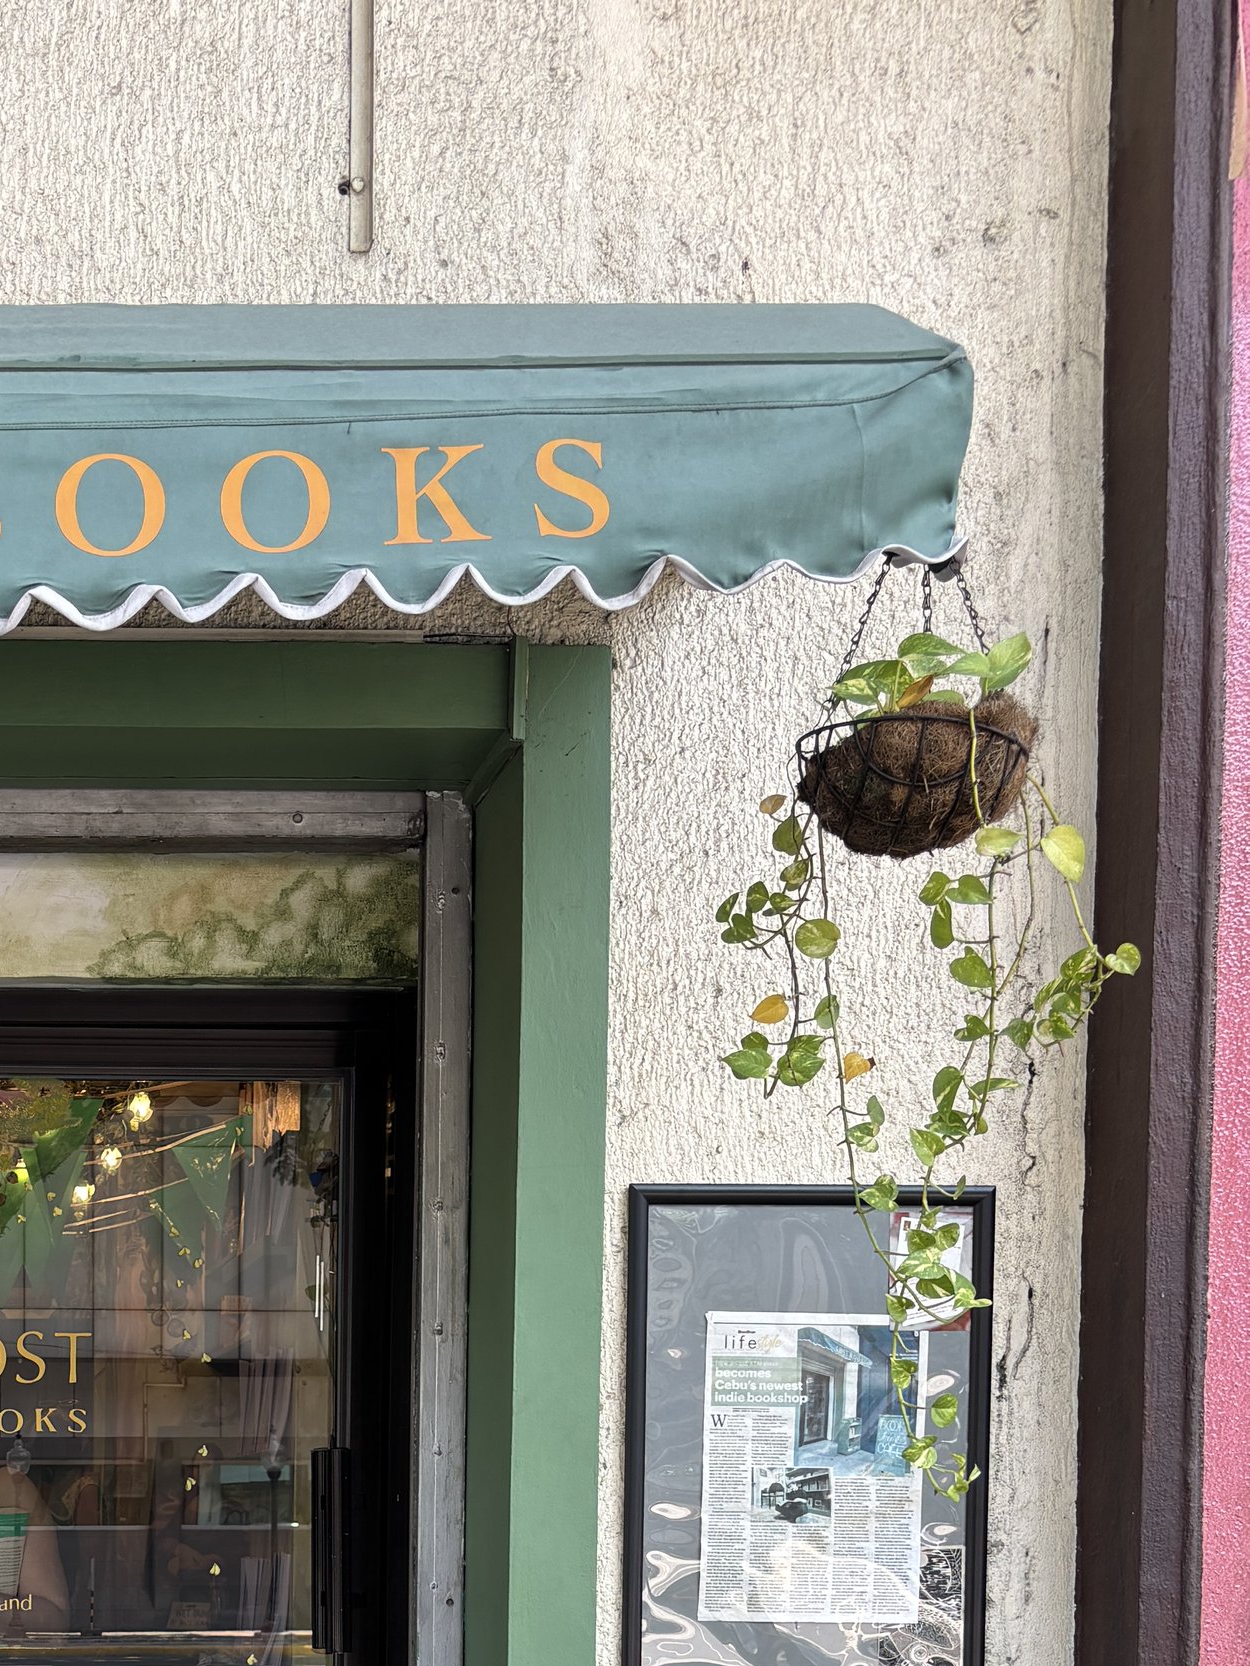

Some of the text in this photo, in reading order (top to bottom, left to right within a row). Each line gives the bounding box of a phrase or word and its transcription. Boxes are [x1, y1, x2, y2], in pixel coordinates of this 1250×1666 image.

[715, 1367, 771, 1378] becomes
[715, 1380, 803, 1391] Cebu's newest
[714, 1392, 809, 1405] indie bookshop
